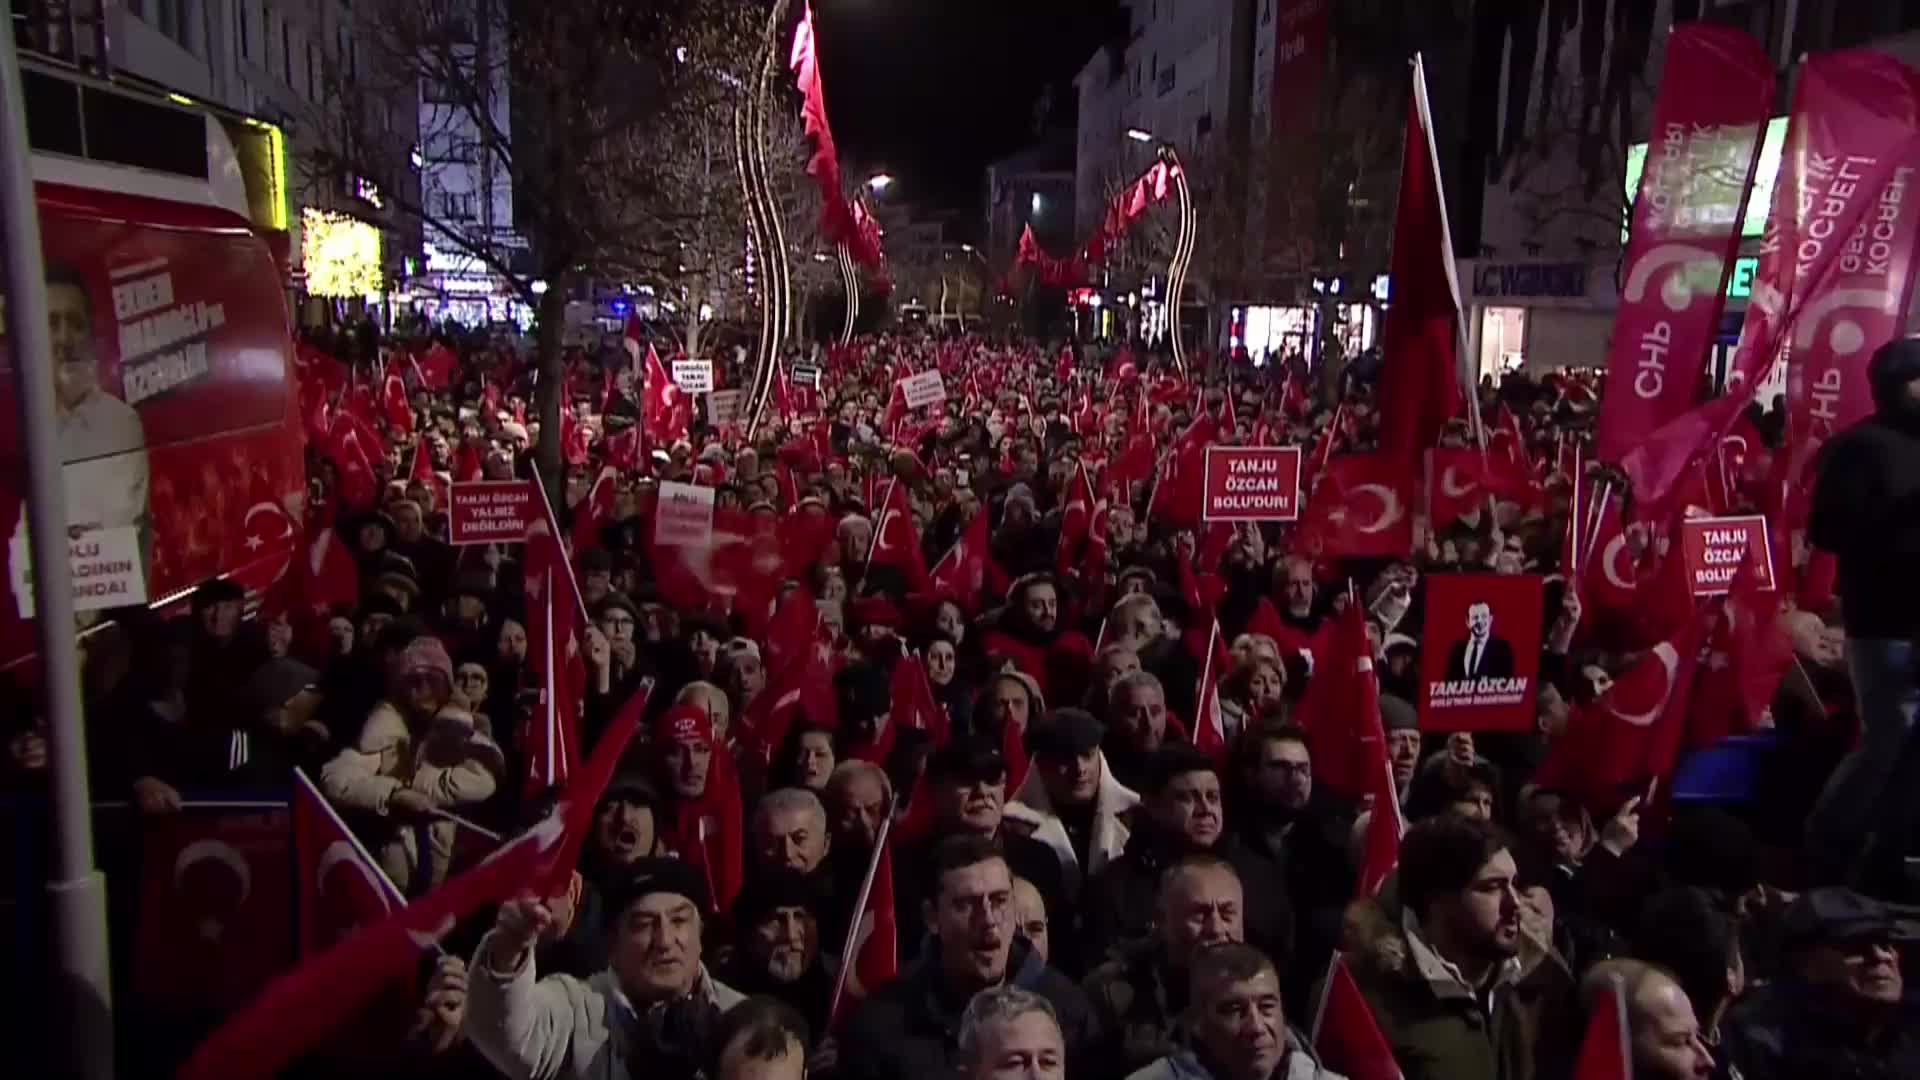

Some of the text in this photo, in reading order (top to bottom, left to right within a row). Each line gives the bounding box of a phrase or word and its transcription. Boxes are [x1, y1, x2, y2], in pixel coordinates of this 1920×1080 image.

[1228, 459, 1277, 473] TANJU
[1225, 475, 1278, 492] ÖZCAN
[1703, 529, 1747, 545] TANJU
[1429, 675, 1528, 697] TANJU ÖZCAN
